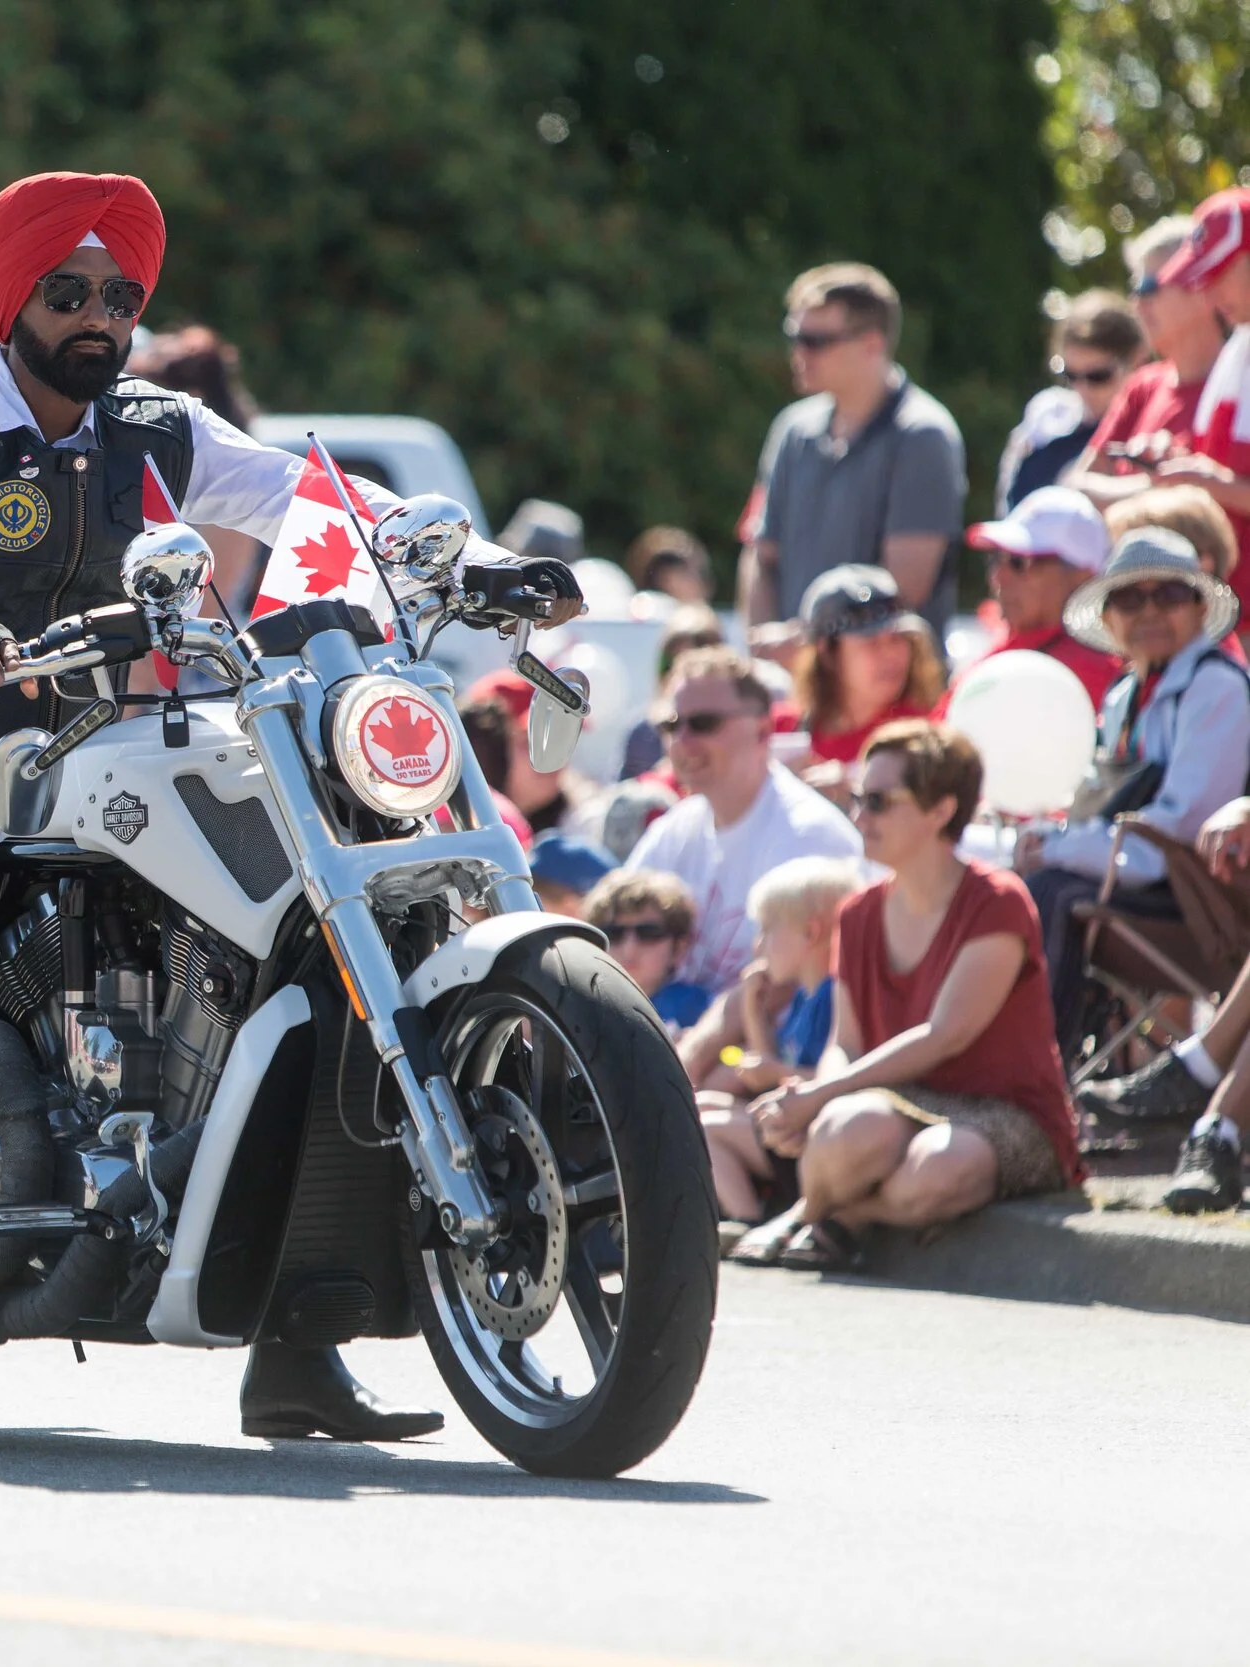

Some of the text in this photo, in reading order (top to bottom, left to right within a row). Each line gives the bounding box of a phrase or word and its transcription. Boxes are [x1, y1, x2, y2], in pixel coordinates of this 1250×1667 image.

[0, 537, 29, 548] CLUB
[392, 757, 432, 771] CANADA
[396, 768, 432, 780] 150 YEARS
[113, 799, 134, 810] MOTOR
[114, 825, 135, 839] CYCLES
